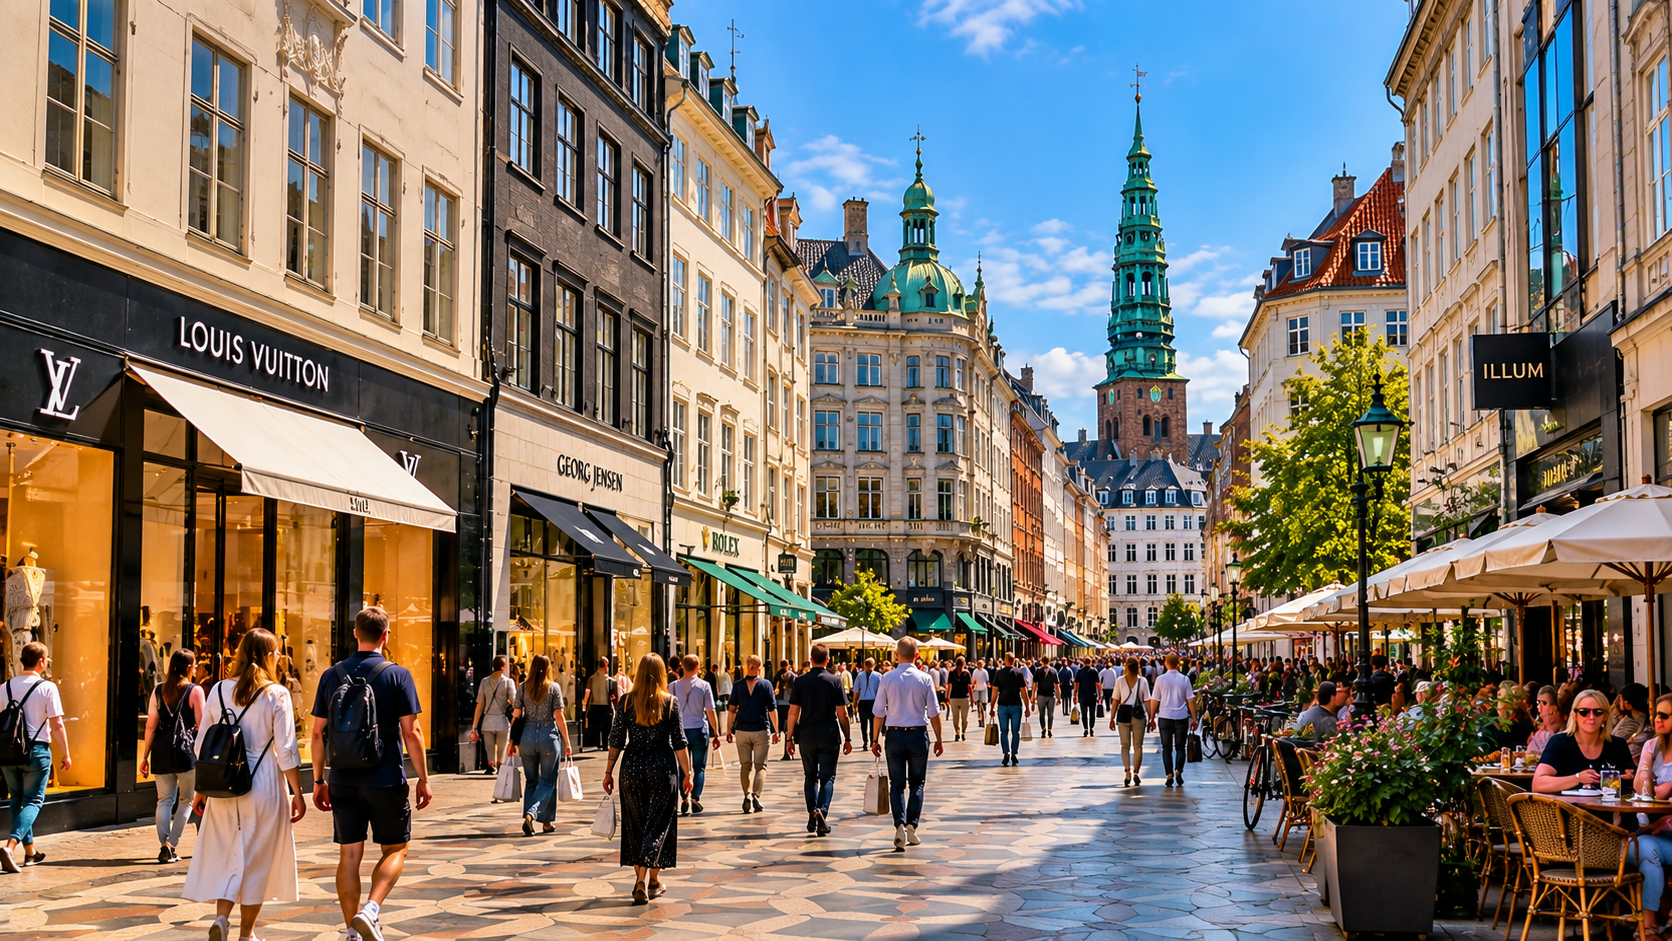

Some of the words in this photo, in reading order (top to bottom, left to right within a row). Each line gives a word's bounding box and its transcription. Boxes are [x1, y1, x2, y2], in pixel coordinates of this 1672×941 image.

[180, 316, 243, 364] LOUIS
[251, 341, 329, 392] VUITTON
[1483, 362, 1544, 379] ILLUM
[557, 454, 590, 484] GEORG
[590, 465, 623, 493] JENSEN
[712, 531, 739, 558] ROLEX
